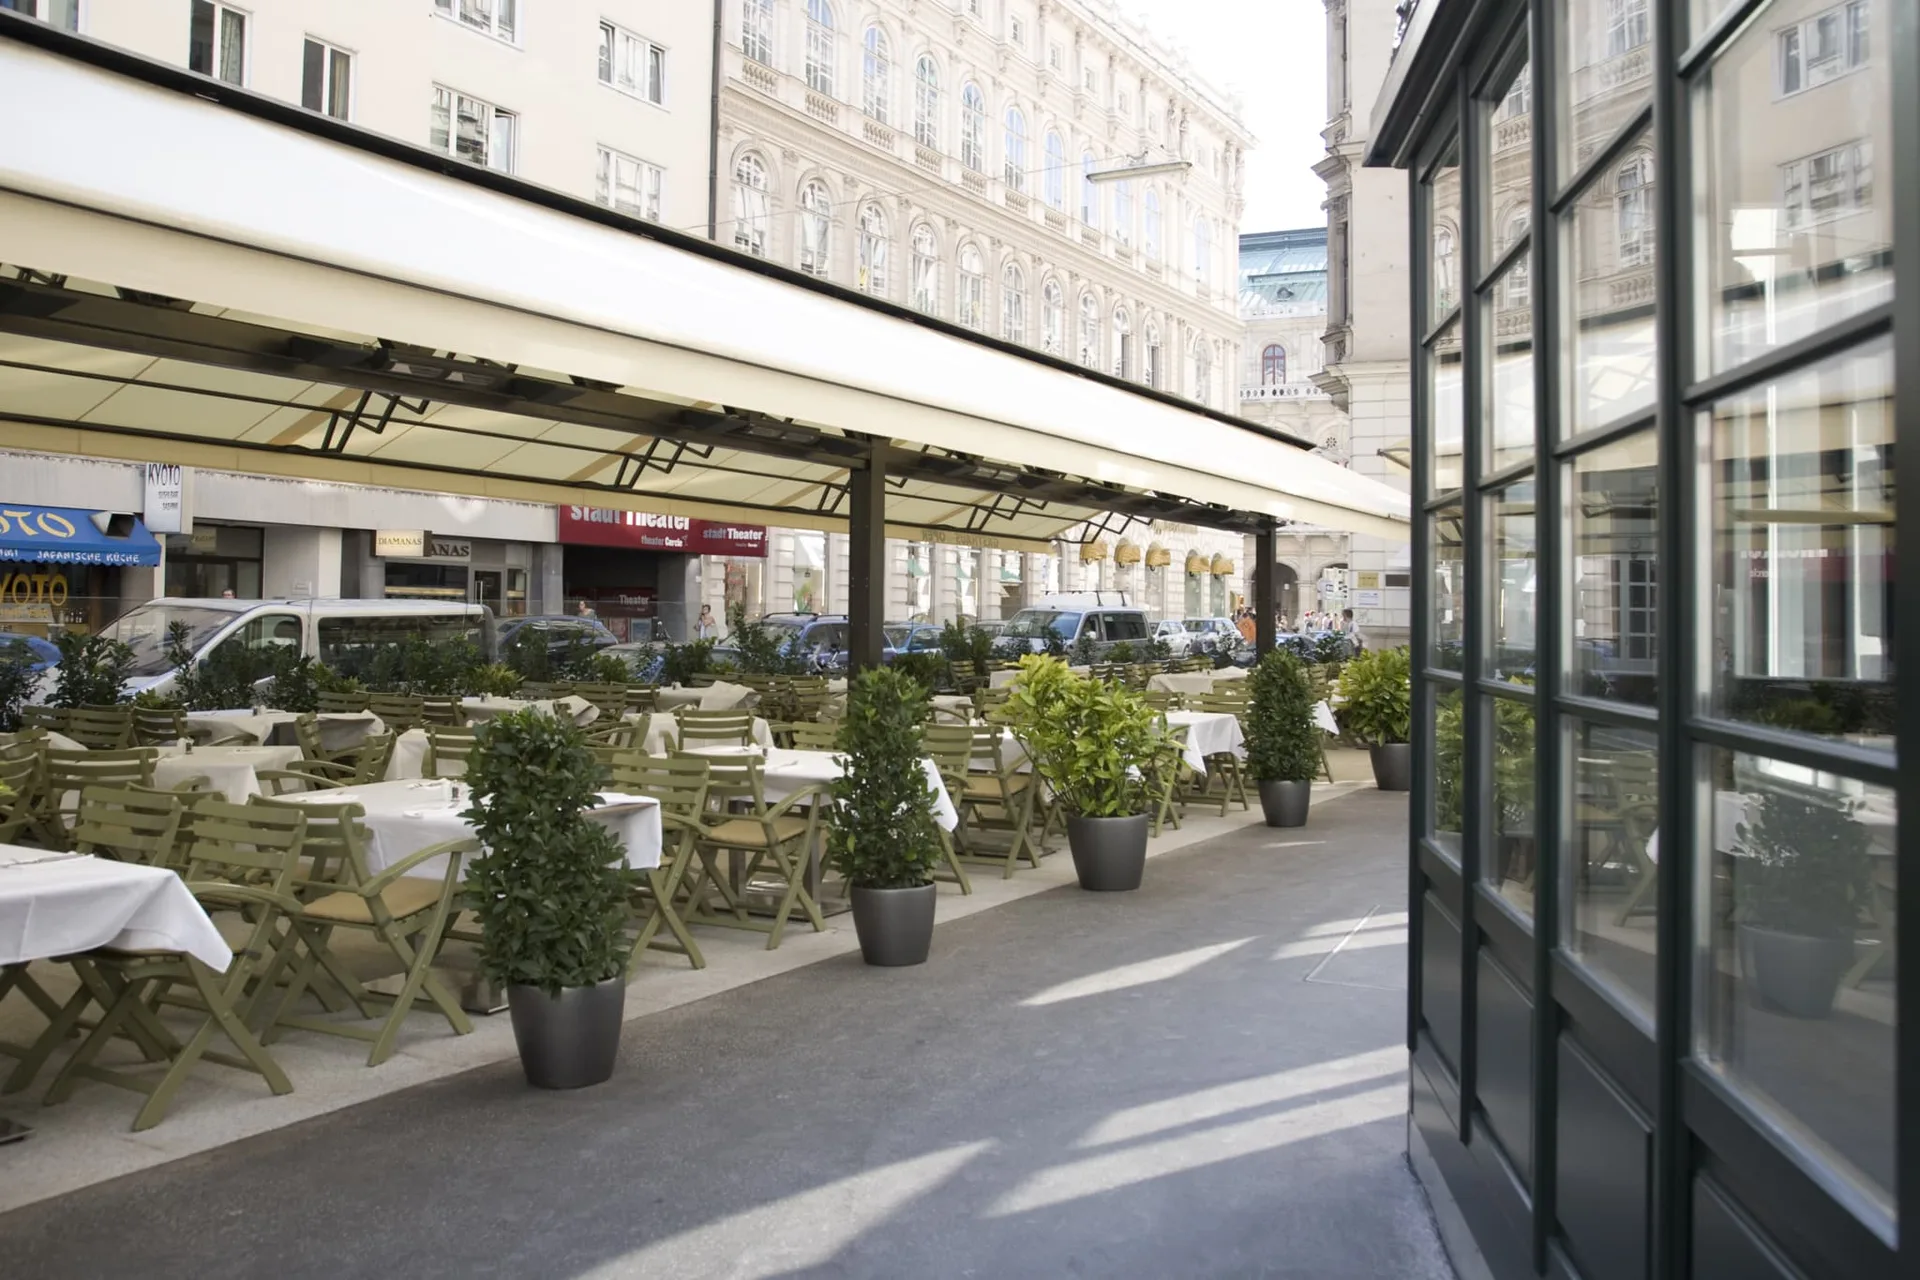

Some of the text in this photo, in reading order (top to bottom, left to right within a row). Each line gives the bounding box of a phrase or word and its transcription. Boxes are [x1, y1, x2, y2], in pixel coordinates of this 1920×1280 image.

[148, 463, 181, 486] KYOTO
[0, 509, 76, 538] TO
[378, 537, 422, 546] DIAMANAS
